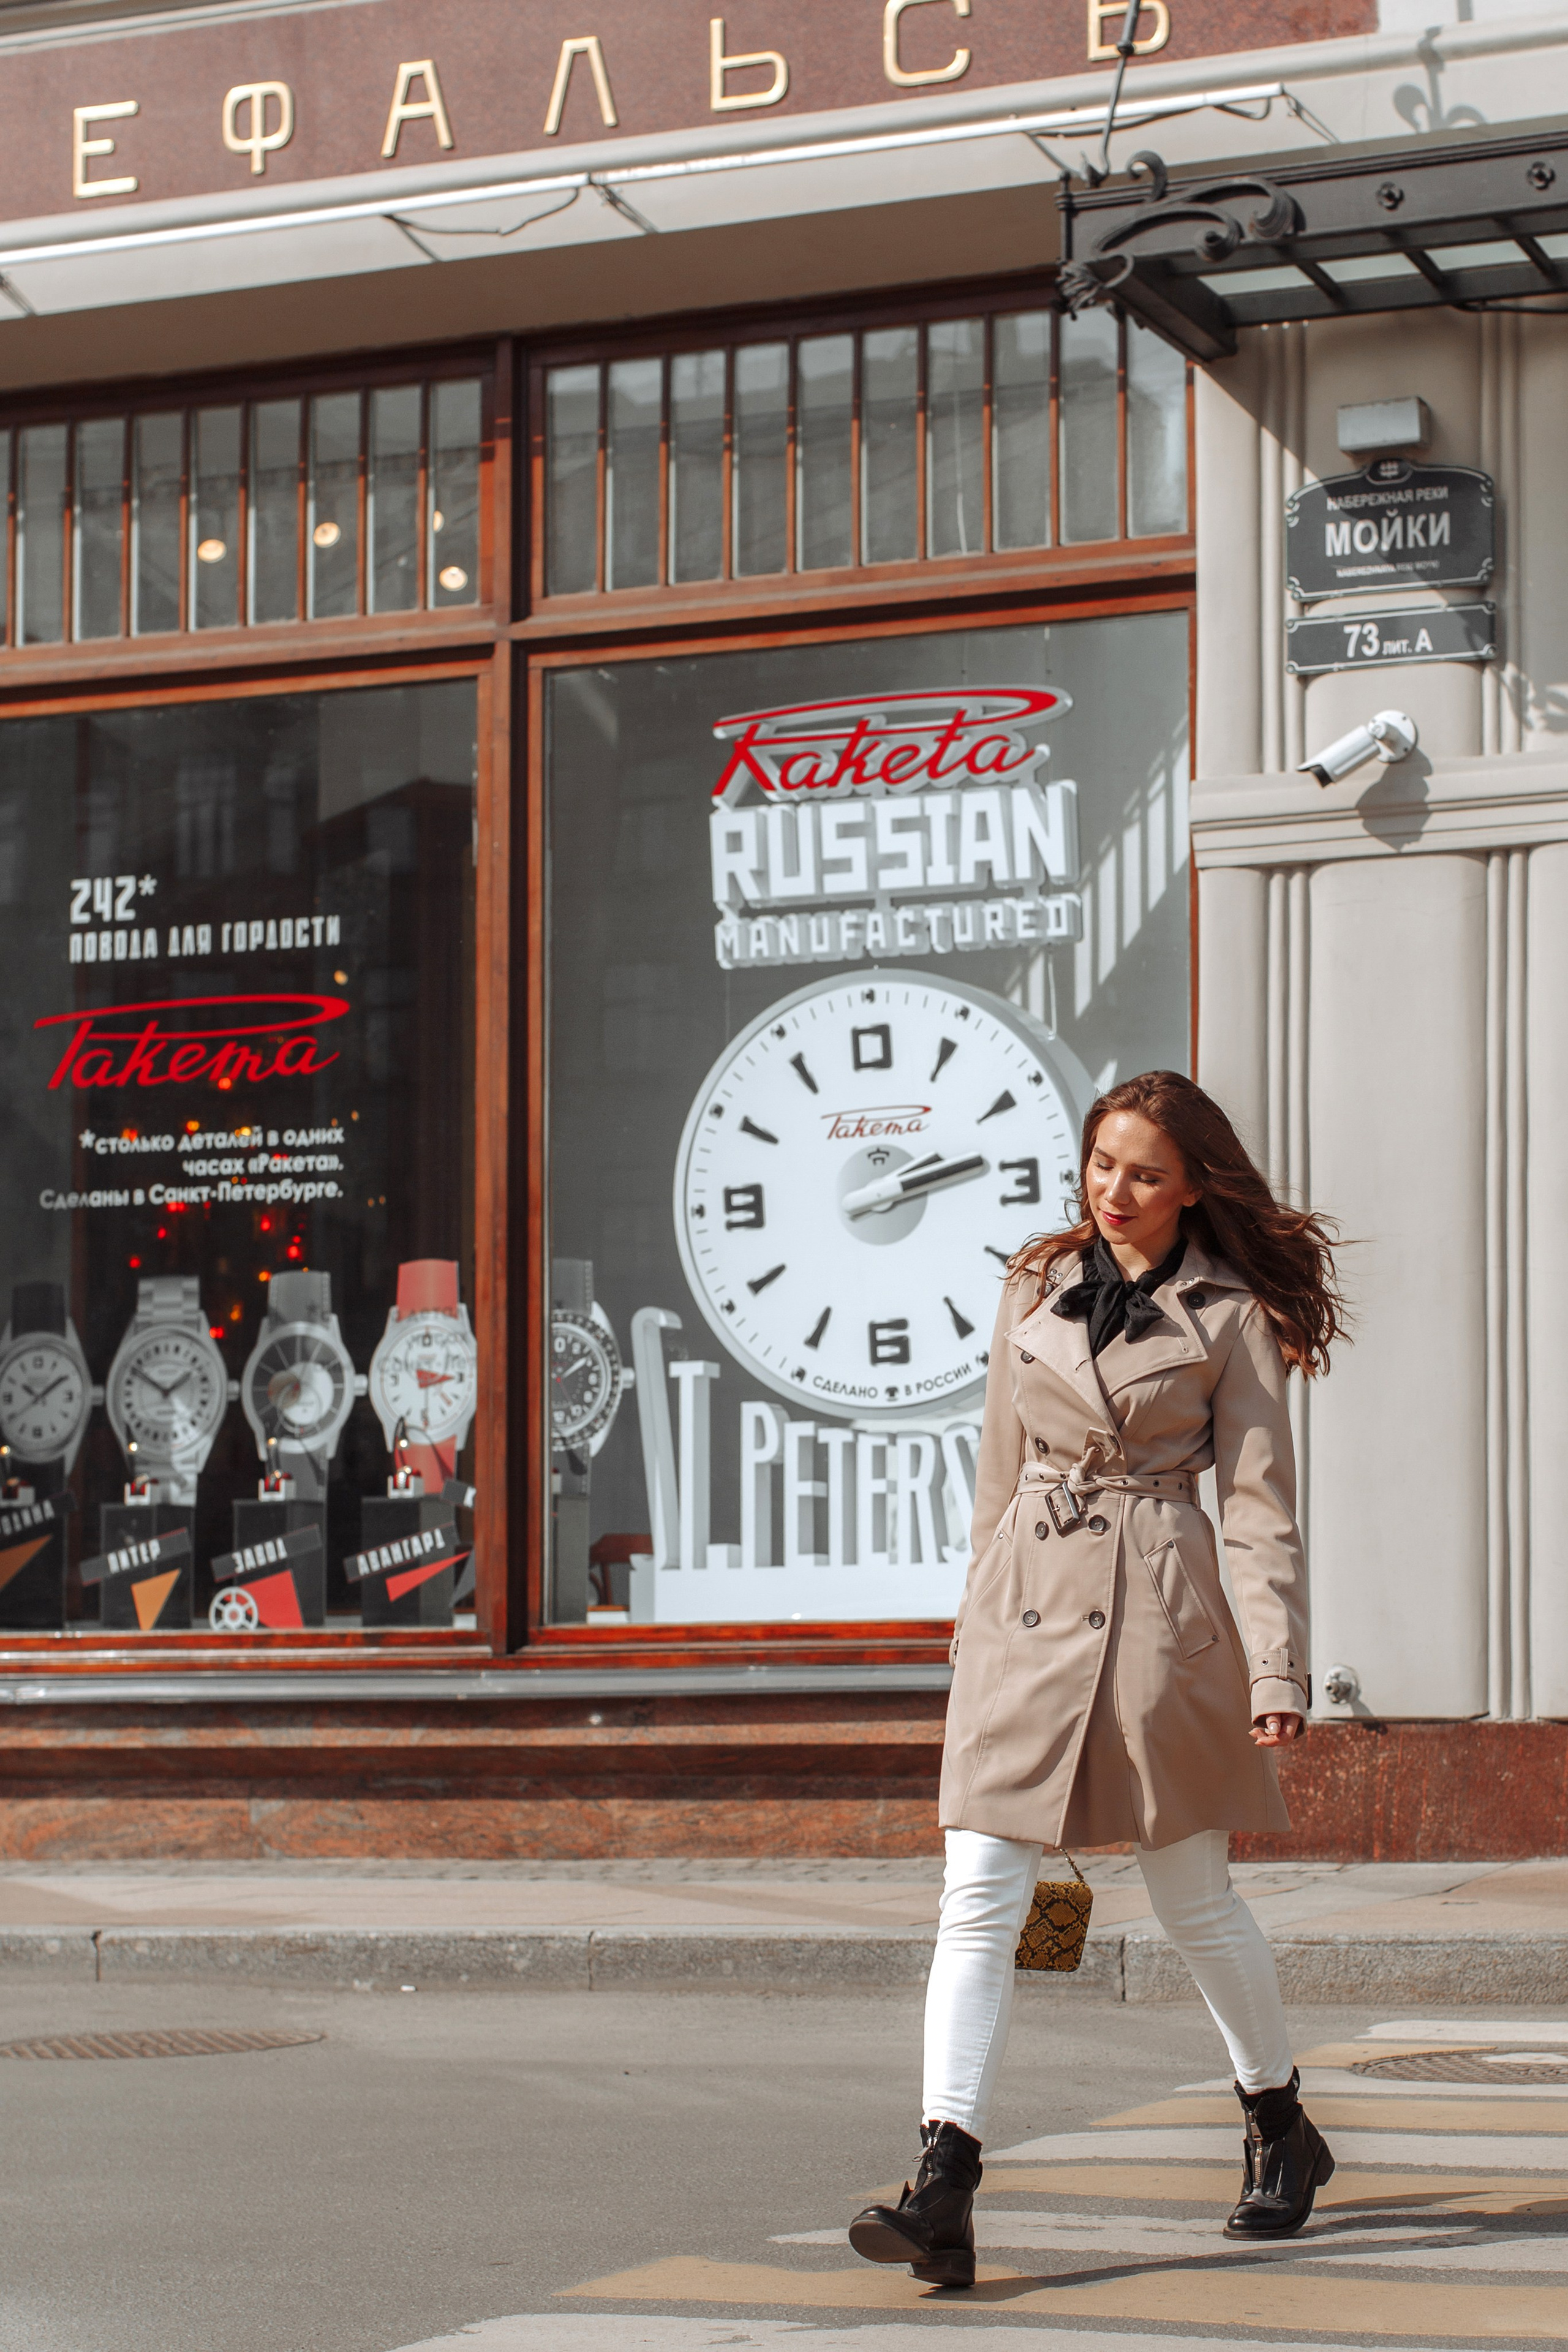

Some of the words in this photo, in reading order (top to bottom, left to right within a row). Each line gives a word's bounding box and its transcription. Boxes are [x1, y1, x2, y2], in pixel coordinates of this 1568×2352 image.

[1327, 489, 1414, 511] НАБЕРЕЖНАЯ
[1415, 486, 1449, 501] РЕКИ
[1325, 508, 1450, 557] МОЙКИ
[1344, 622, 1380, 658] 73
[1415, 628, 1433, 652] А
[711, 688, 1058, 797] Raketa
[709, 782, 1069, 903] RUSSIAN
[69, 927, 158, 964] ПОВОДА
[167, 923, 211, 957] ДЛЯ
[221, 914, 341, 953] ГОРДОСТИ
[714, 895, 1072, 963] MANUFACTURED
[177, 1125, 263, 1153] деталей
[266, 1129, 279, 1147] в
[282, 1126, 345, 1148] одних
[182, 1157, 245, 1177] часах
[998, 1157, 1041, 1206] 3
[39, 1188, 129, 1210] Сделаны
[132, 1188, 145, 1205] в
[148, 1178, 344, 1205] Санкт-Петербурге.
[812, 1375, 878, 1399] СДЕЛАНО
[904, 1385, 913, 1396] В
[916, 1363, 972, 1394] РОССИИ
